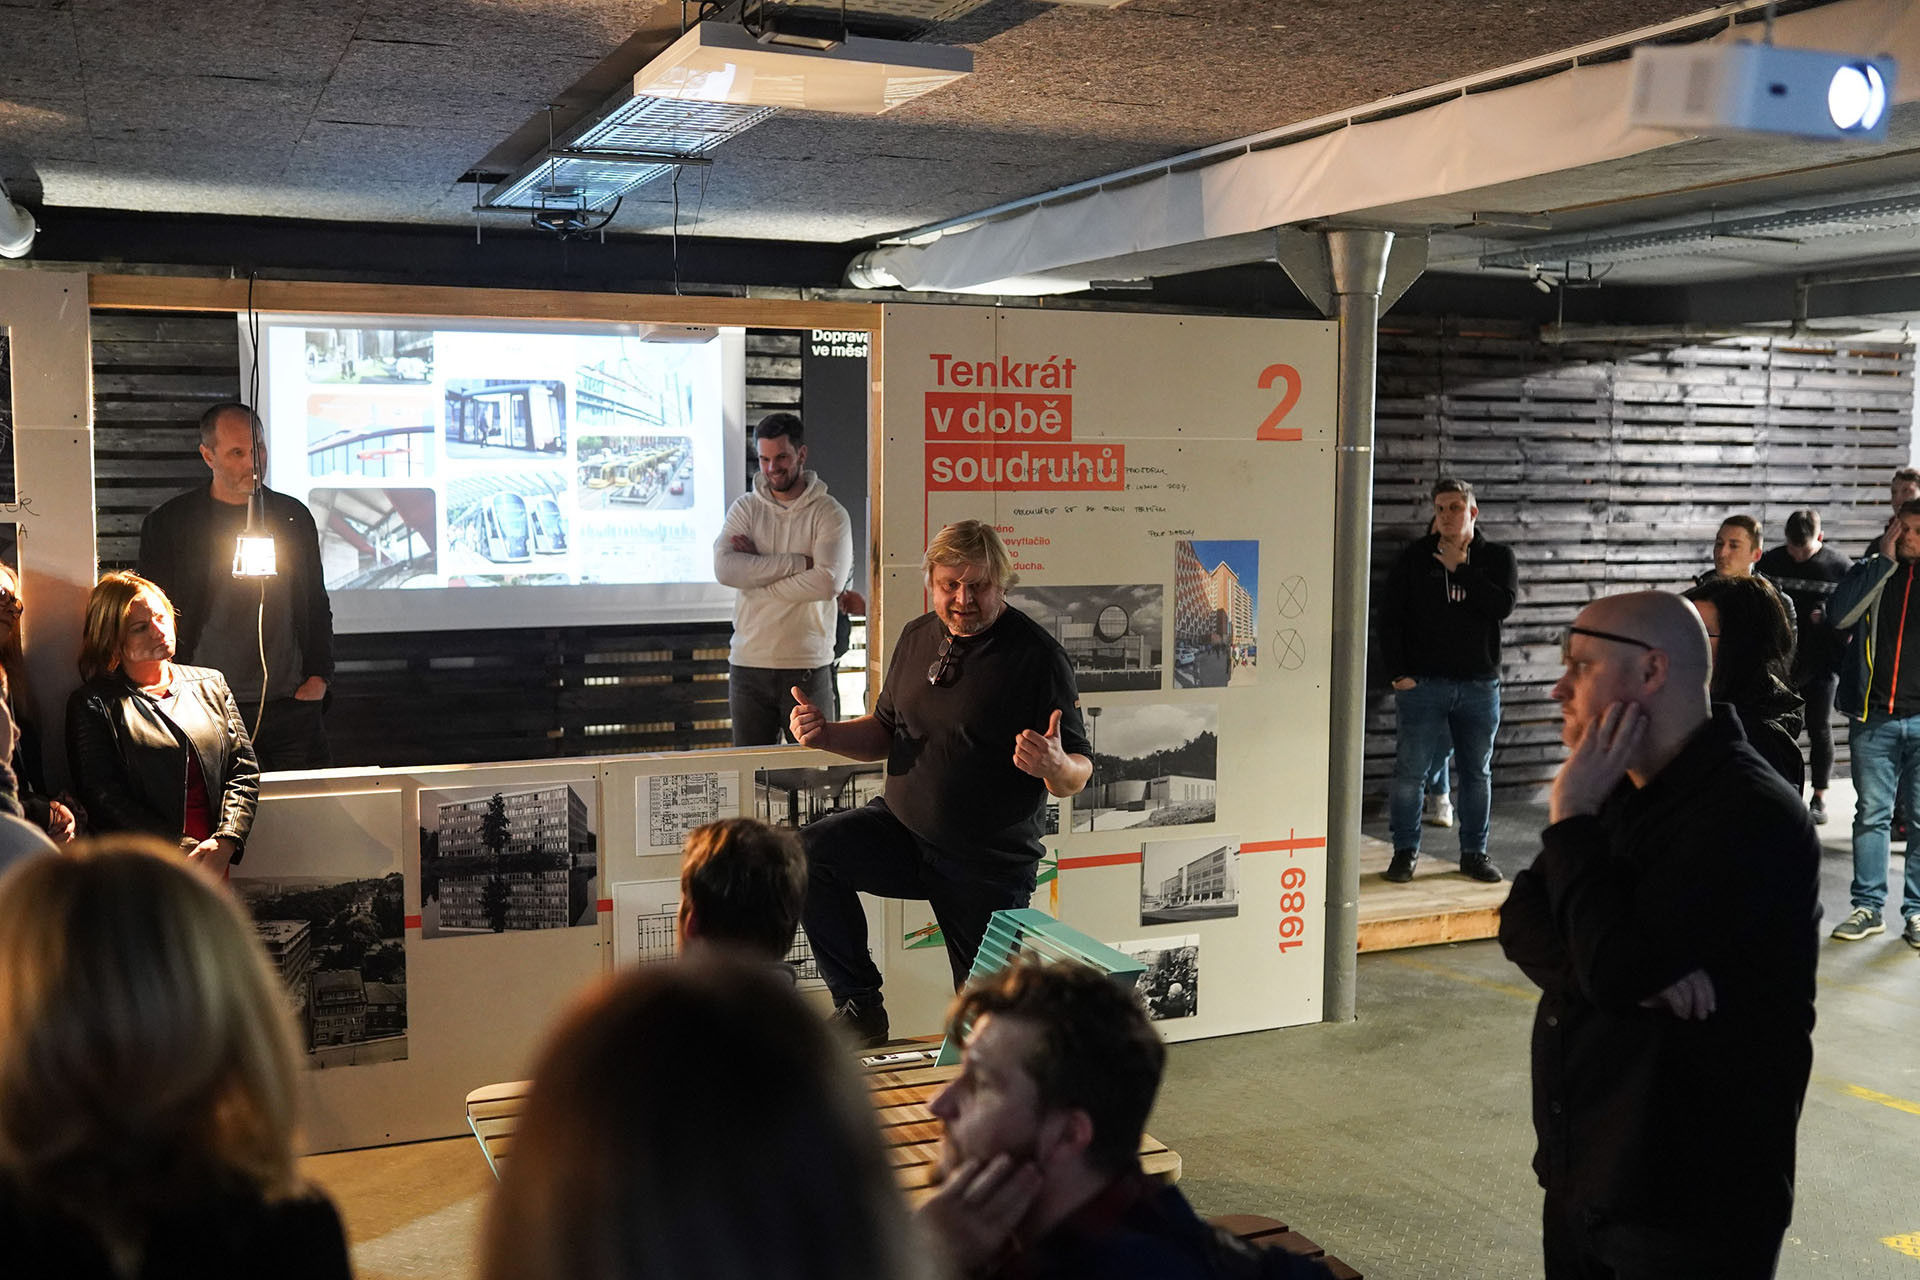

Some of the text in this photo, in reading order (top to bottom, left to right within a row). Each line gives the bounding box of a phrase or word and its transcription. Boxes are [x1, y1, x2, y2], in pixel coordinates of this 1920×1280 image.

[811, 343, 868, 357] ve měst
[930, 354, 1076, 389] Tenkrát
[931, 401, 1062, 434] v době
[1257, 364, 1303, 441] 2
[932, 448, 1119, 484] soudruhů
[1013, 562, 1045, 570] ducha.
[1279, 867, 1306, 954] 1989
